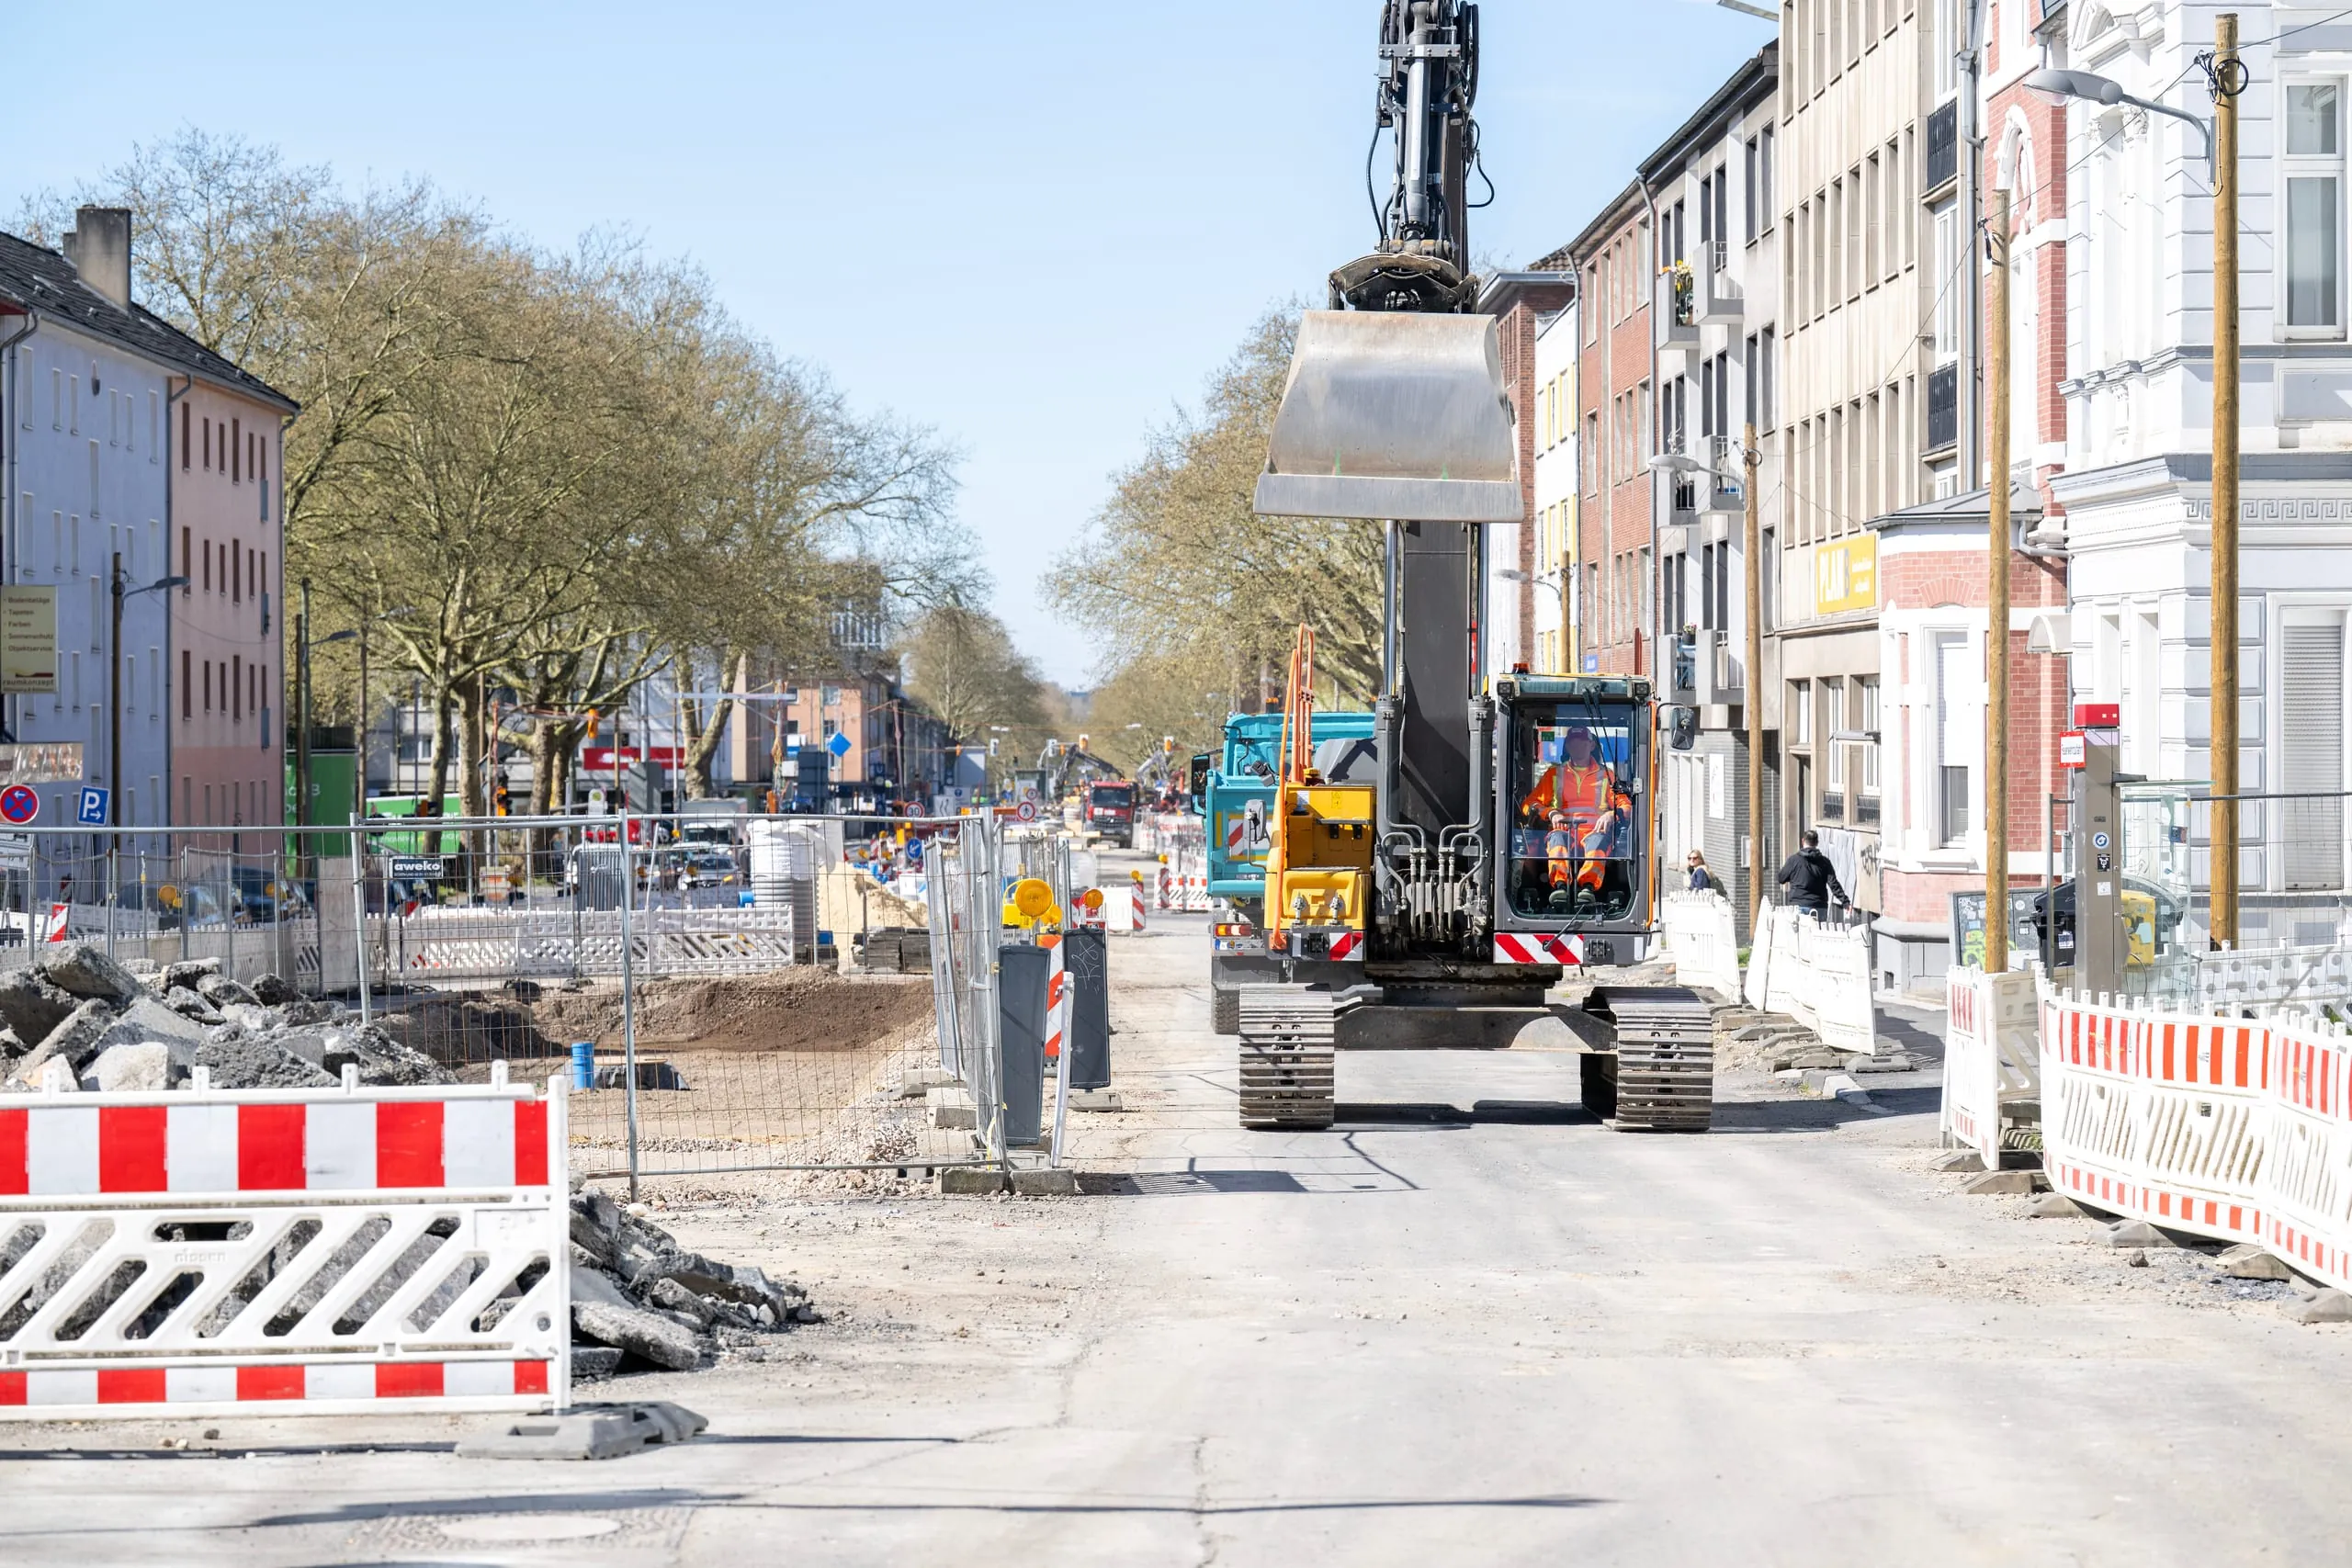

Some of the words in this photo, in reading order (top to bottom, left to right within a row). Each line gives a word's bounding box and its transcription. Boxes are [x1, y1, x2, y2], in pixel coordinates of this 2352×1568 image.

[3, 678, 54, 687] raumkonzept
[83, 792, 100, 818] P
[909, 807, 921, 817] 30
[394, 860, 441, 871] aweko
